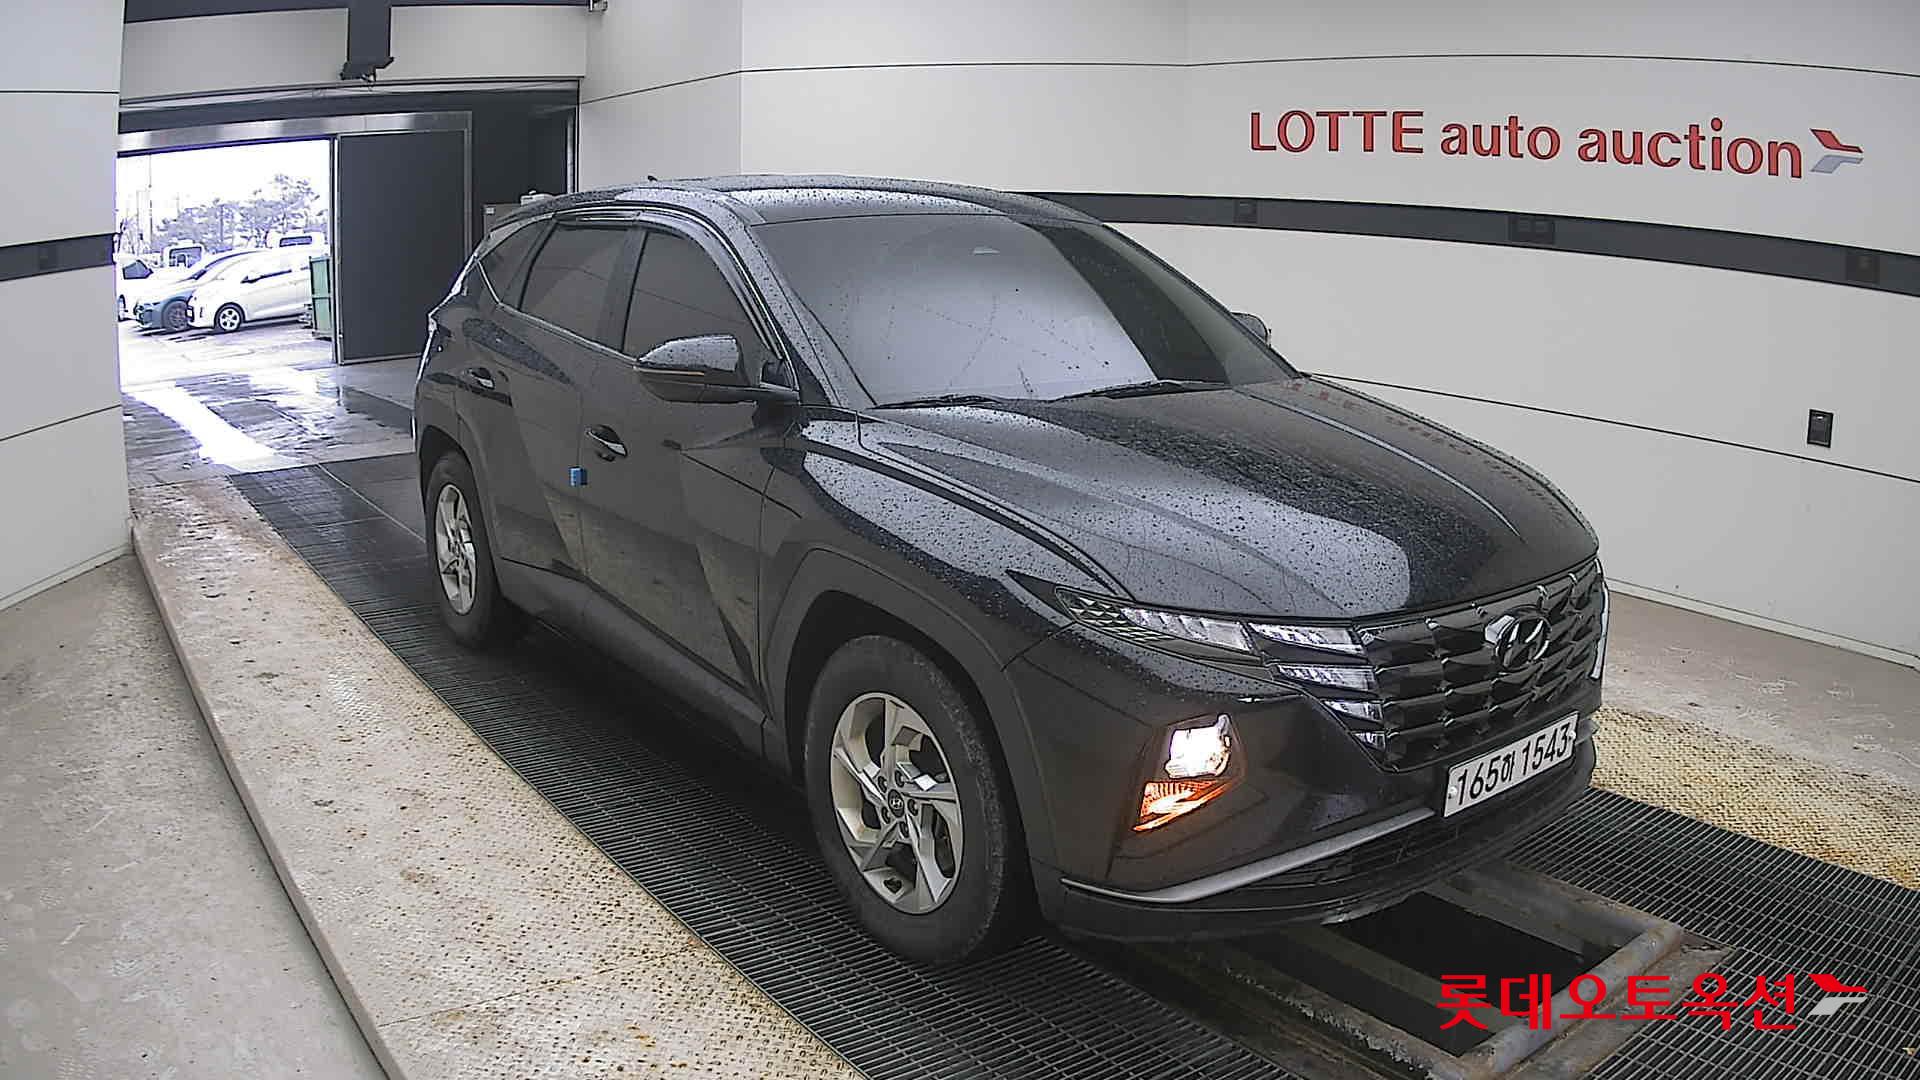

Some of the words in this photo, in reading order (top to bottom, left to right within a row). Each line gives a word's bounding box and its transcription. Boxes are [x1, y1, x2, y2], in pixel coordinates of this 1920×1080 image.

[1251, 110, 1424, 153] LOTTE
[1440, 115, 1561, 160] auto
[1577, 117, 1803, 179] auction
[1457, 750, 1516, 806] 165하
[1522, 722, 1571, 776] 1543
